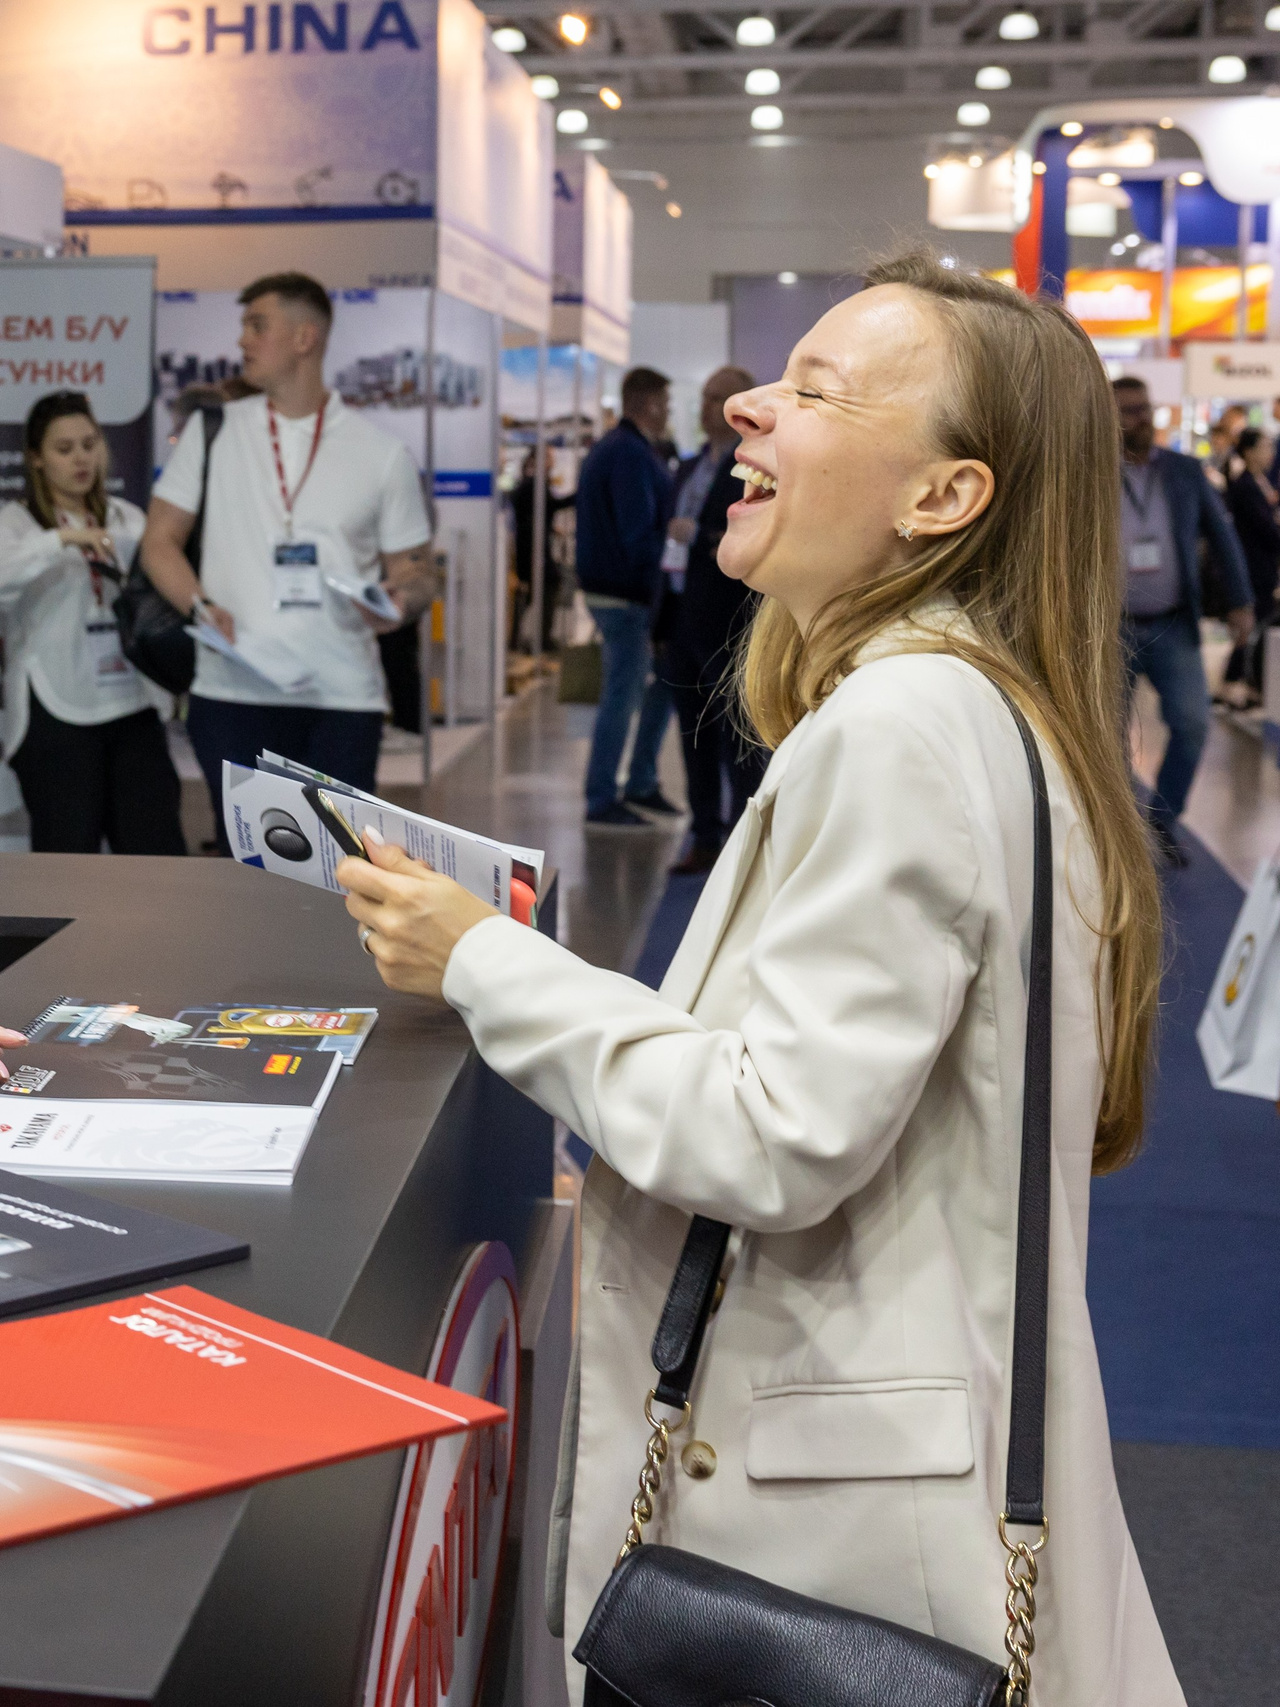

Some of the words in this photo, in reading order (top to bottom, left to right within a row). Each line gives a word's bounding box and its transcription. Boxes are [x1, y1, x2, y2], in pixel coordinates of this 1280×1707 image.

[142, 1, 420, 54] CHINA
[65, 315, 129, 342] Б/У
[9, 1113, 59, 1149] TAKAYAMA
[109, 1314, 247, 1367] КАТАЛОГ
